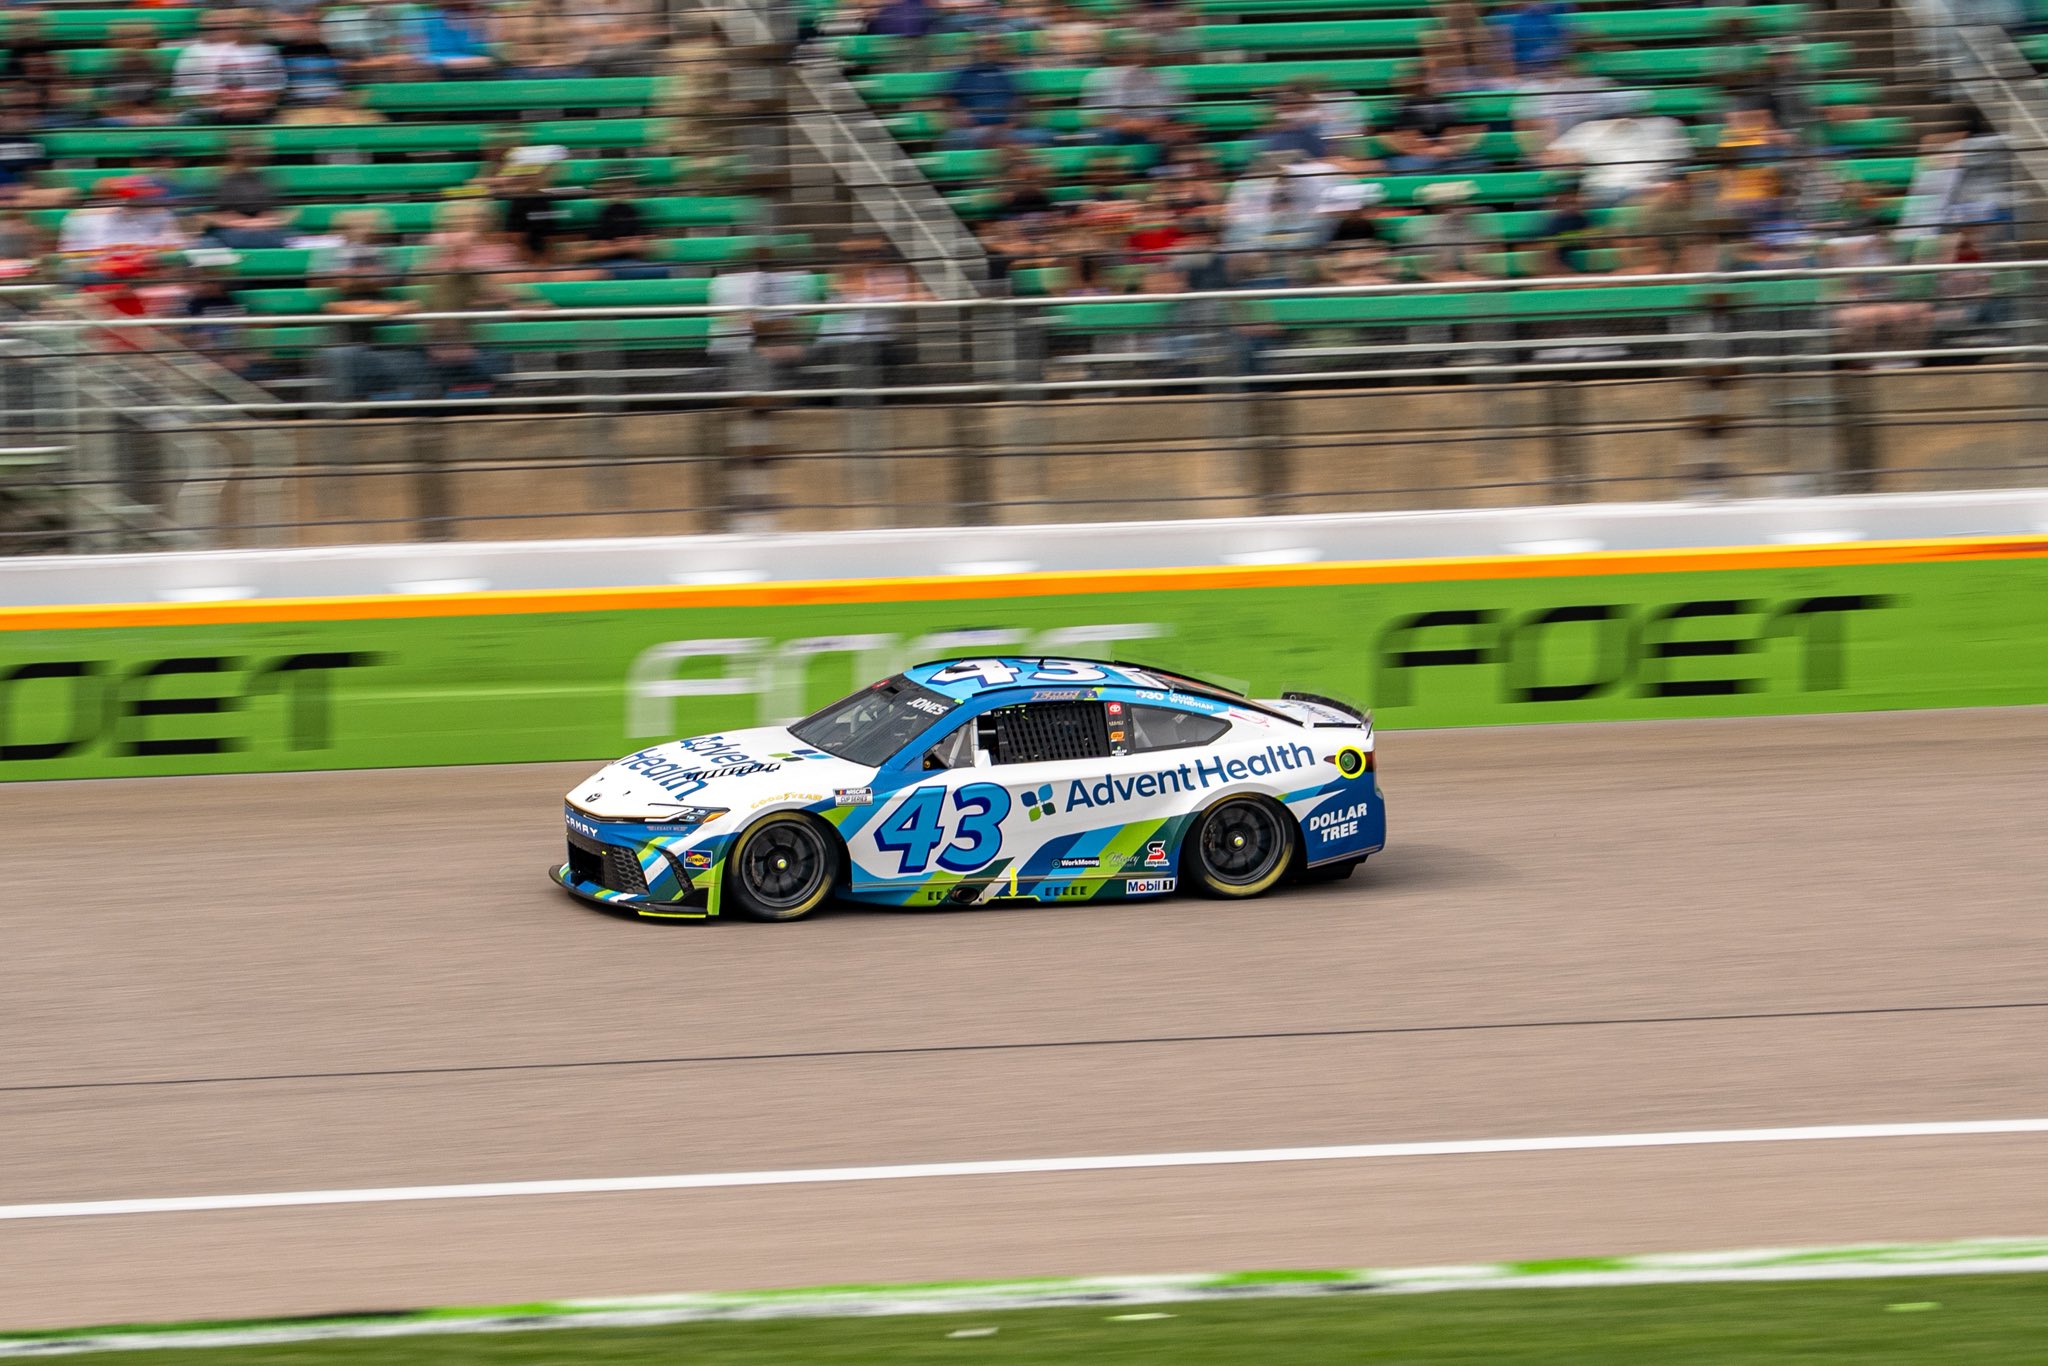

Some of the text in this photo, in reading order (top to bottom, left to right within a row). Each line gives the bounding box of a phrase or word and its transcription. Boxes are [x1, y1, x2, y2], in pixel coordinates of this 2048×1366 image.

[906, 697, 949, 715] JONES
[1169, 697, 1214, 711] WYNDHAM
[1066, 742, 1315, 813] AdventHealth
[751, 792, 823, 809] GOODYEAR
[565, 814, 598, 837] CAMRY
[1309, 803, 1368, 831] DOLLAR
[873, 782, 1012, 874] 43
[1321, 821, 1358, 843] TREE
[1061, 858, 1099, 867] WorkMoney
[1128, 881, 1160, 892] Mobil
